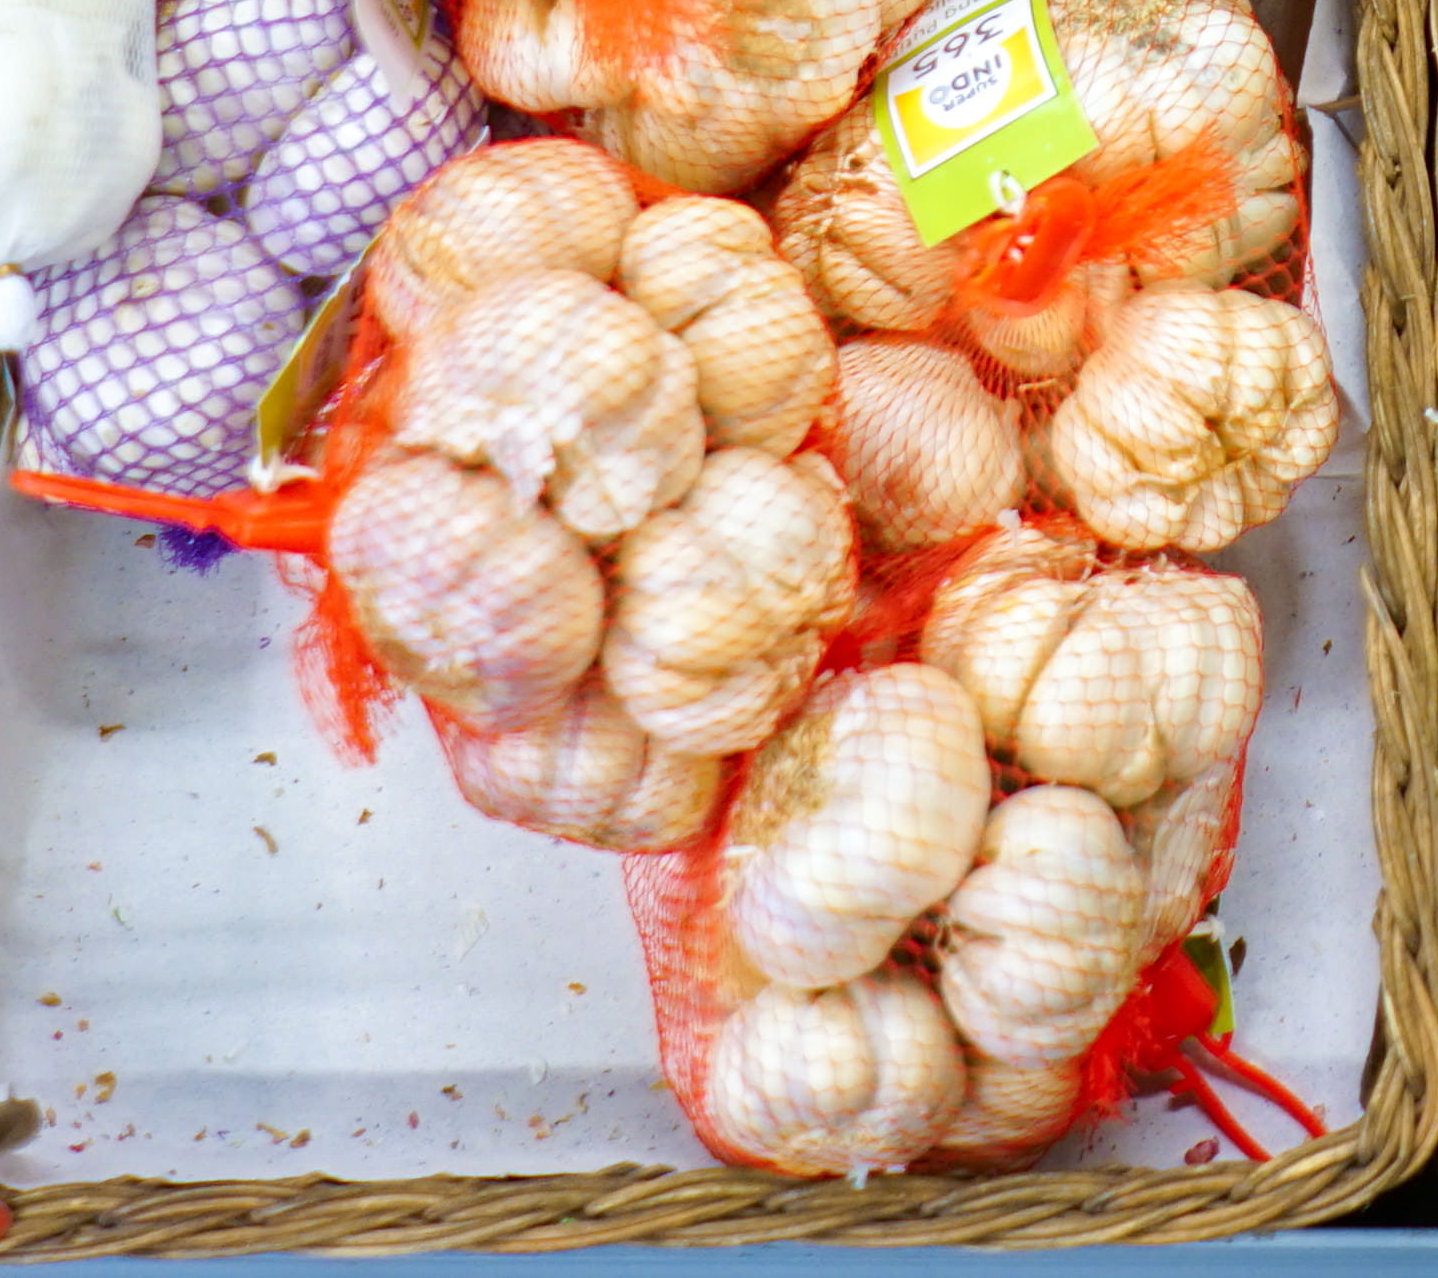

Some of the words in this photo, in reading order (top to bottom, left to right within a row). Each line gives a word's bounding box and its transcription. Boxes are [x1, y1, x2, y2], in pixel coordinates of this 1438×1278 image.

[913, 13, 1003, 79] 365
[929, 54, 1002, 105] INDO
[943, 74, 999, 111] SUPER
